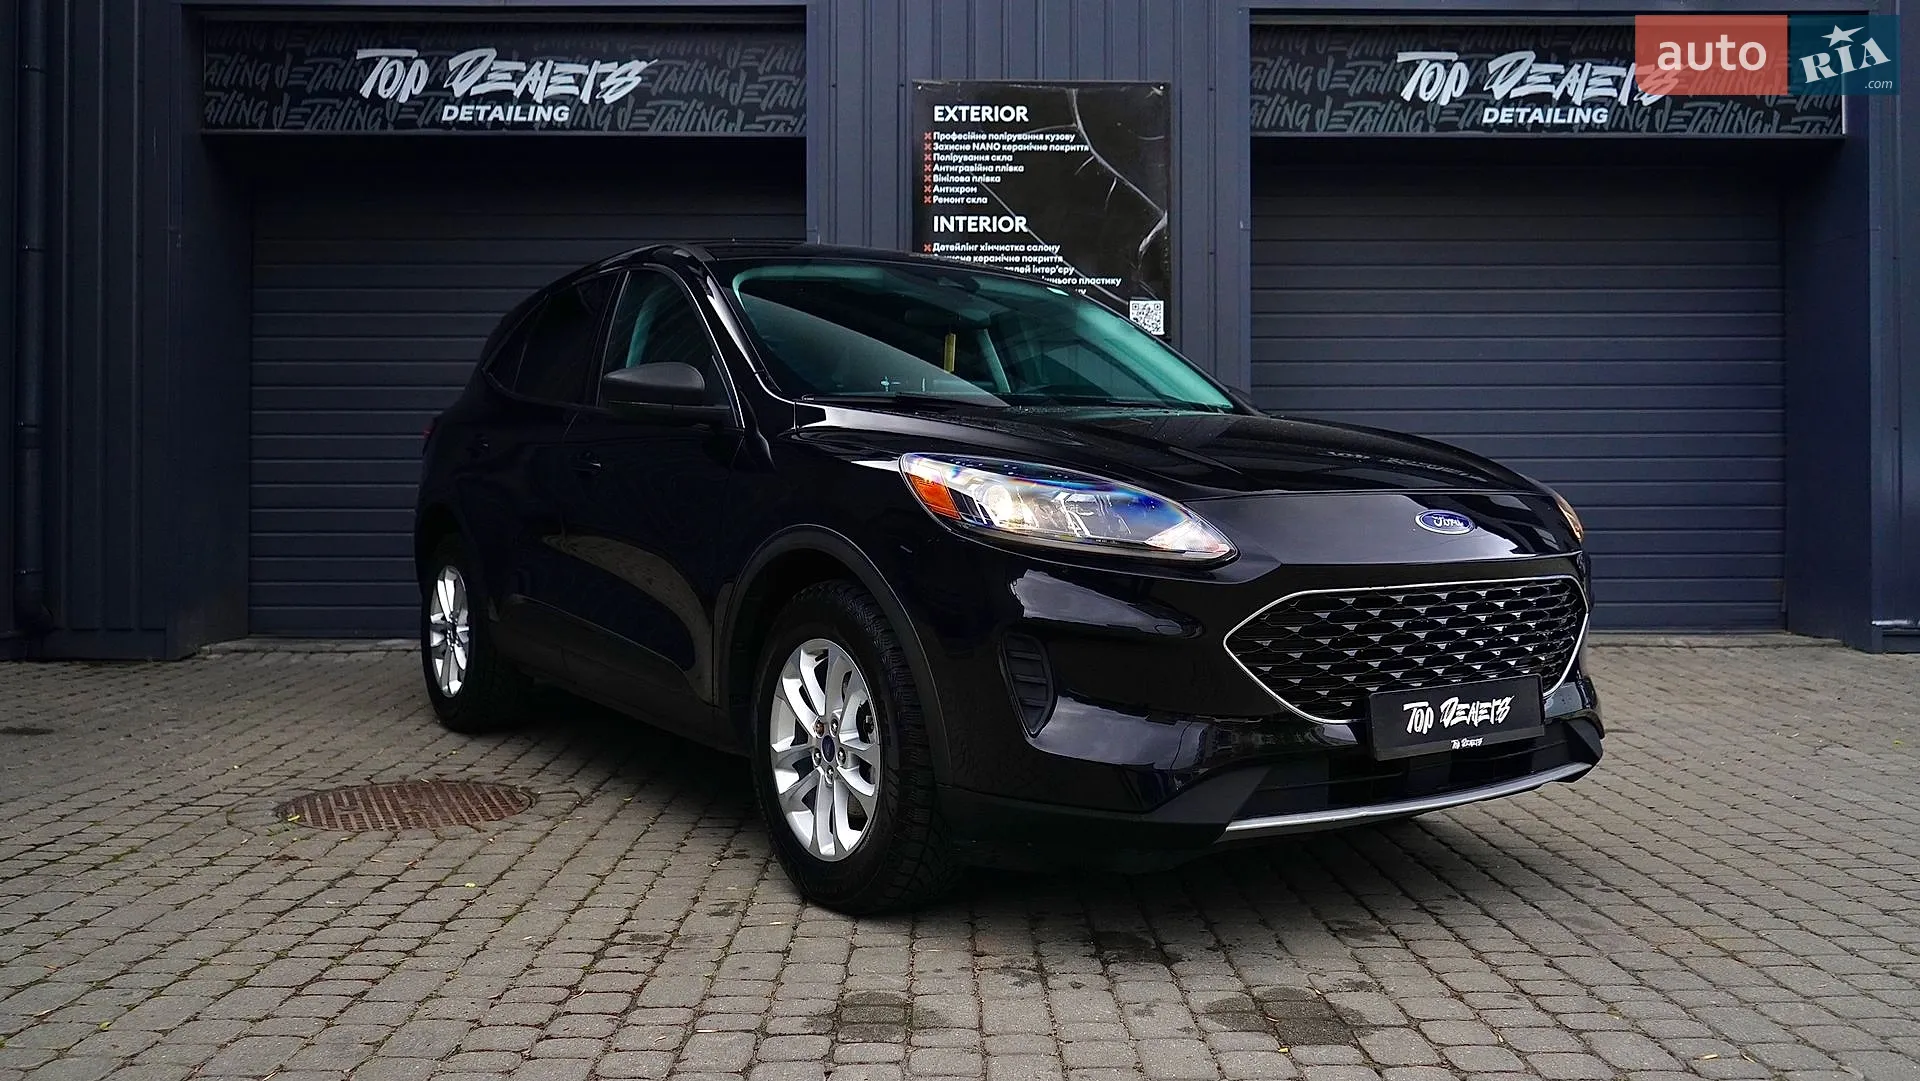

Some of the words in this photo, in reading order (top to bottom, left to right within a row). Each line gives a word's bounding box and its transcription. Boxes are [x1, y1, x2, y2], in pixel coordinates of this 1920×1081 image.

[441, 105, 570, 122] DETAILING
[933, 105, 1029, 122] EXTERIOR
[1482, 107, 1609, 124] DETAILING
[1045, 133, 1076, 142] кузову
[933, 142, 971, 151] Захисне
[972, 142, 1001, 151] NANO
[991, 154, 1013, 162] скла
[933, 195, 965, 204] Ремонт
[965, 196, 988, 204] скла
[933, 215, 1027, 233] INTERIOR
[1026, 243, 1060, 253] салону
[1078, 276, 1122, 286] пластику
[1431, 513, 1467, 528] Ford
